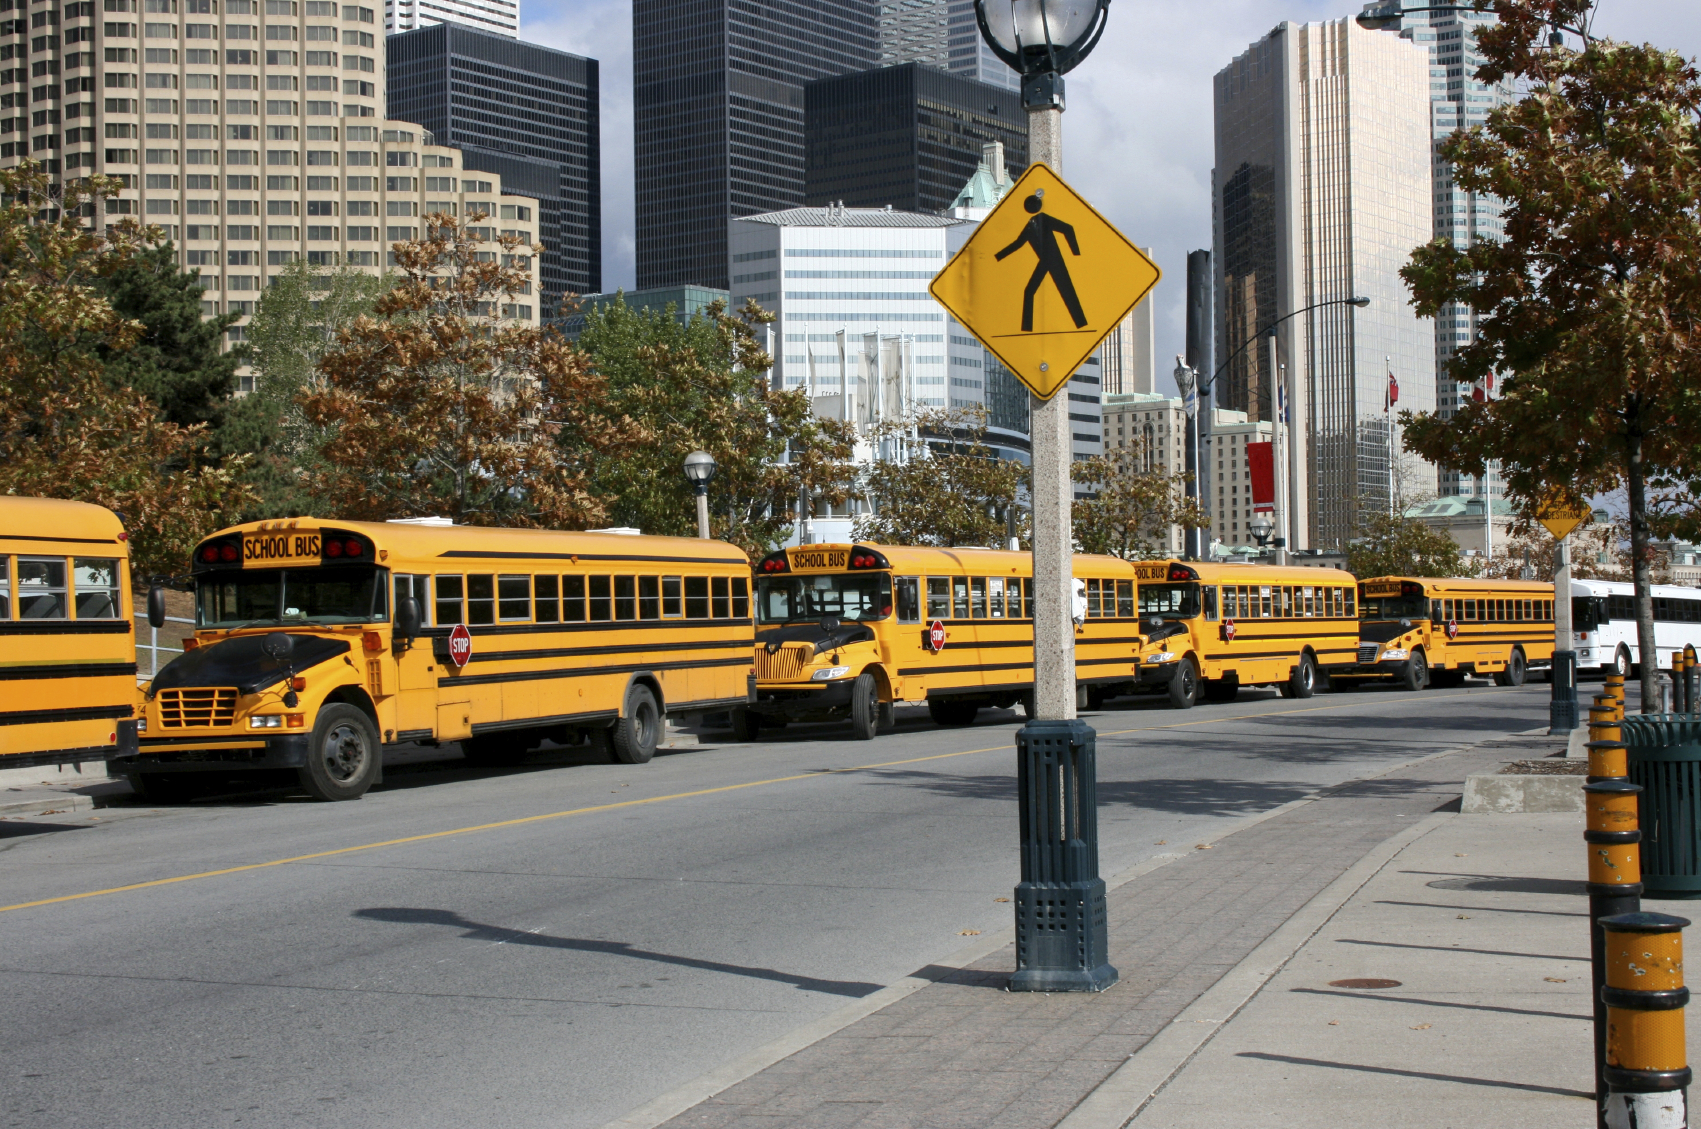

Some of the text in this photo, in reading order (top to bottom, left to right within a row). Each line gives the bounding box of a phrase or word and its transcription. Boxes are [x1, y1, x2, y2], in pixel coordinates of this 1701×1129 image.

[245, 535, 320, 560] SCHOOL BUS
[794, 552, 845, 568] SCHOOL BUS
[1134, 567, 1165, 580] OOL BUS
[1366, 583, 1400, 594] SCHOOL BUS
[932, 629, 944, 641] STOP
[452, 637, 469, 653] STOP
